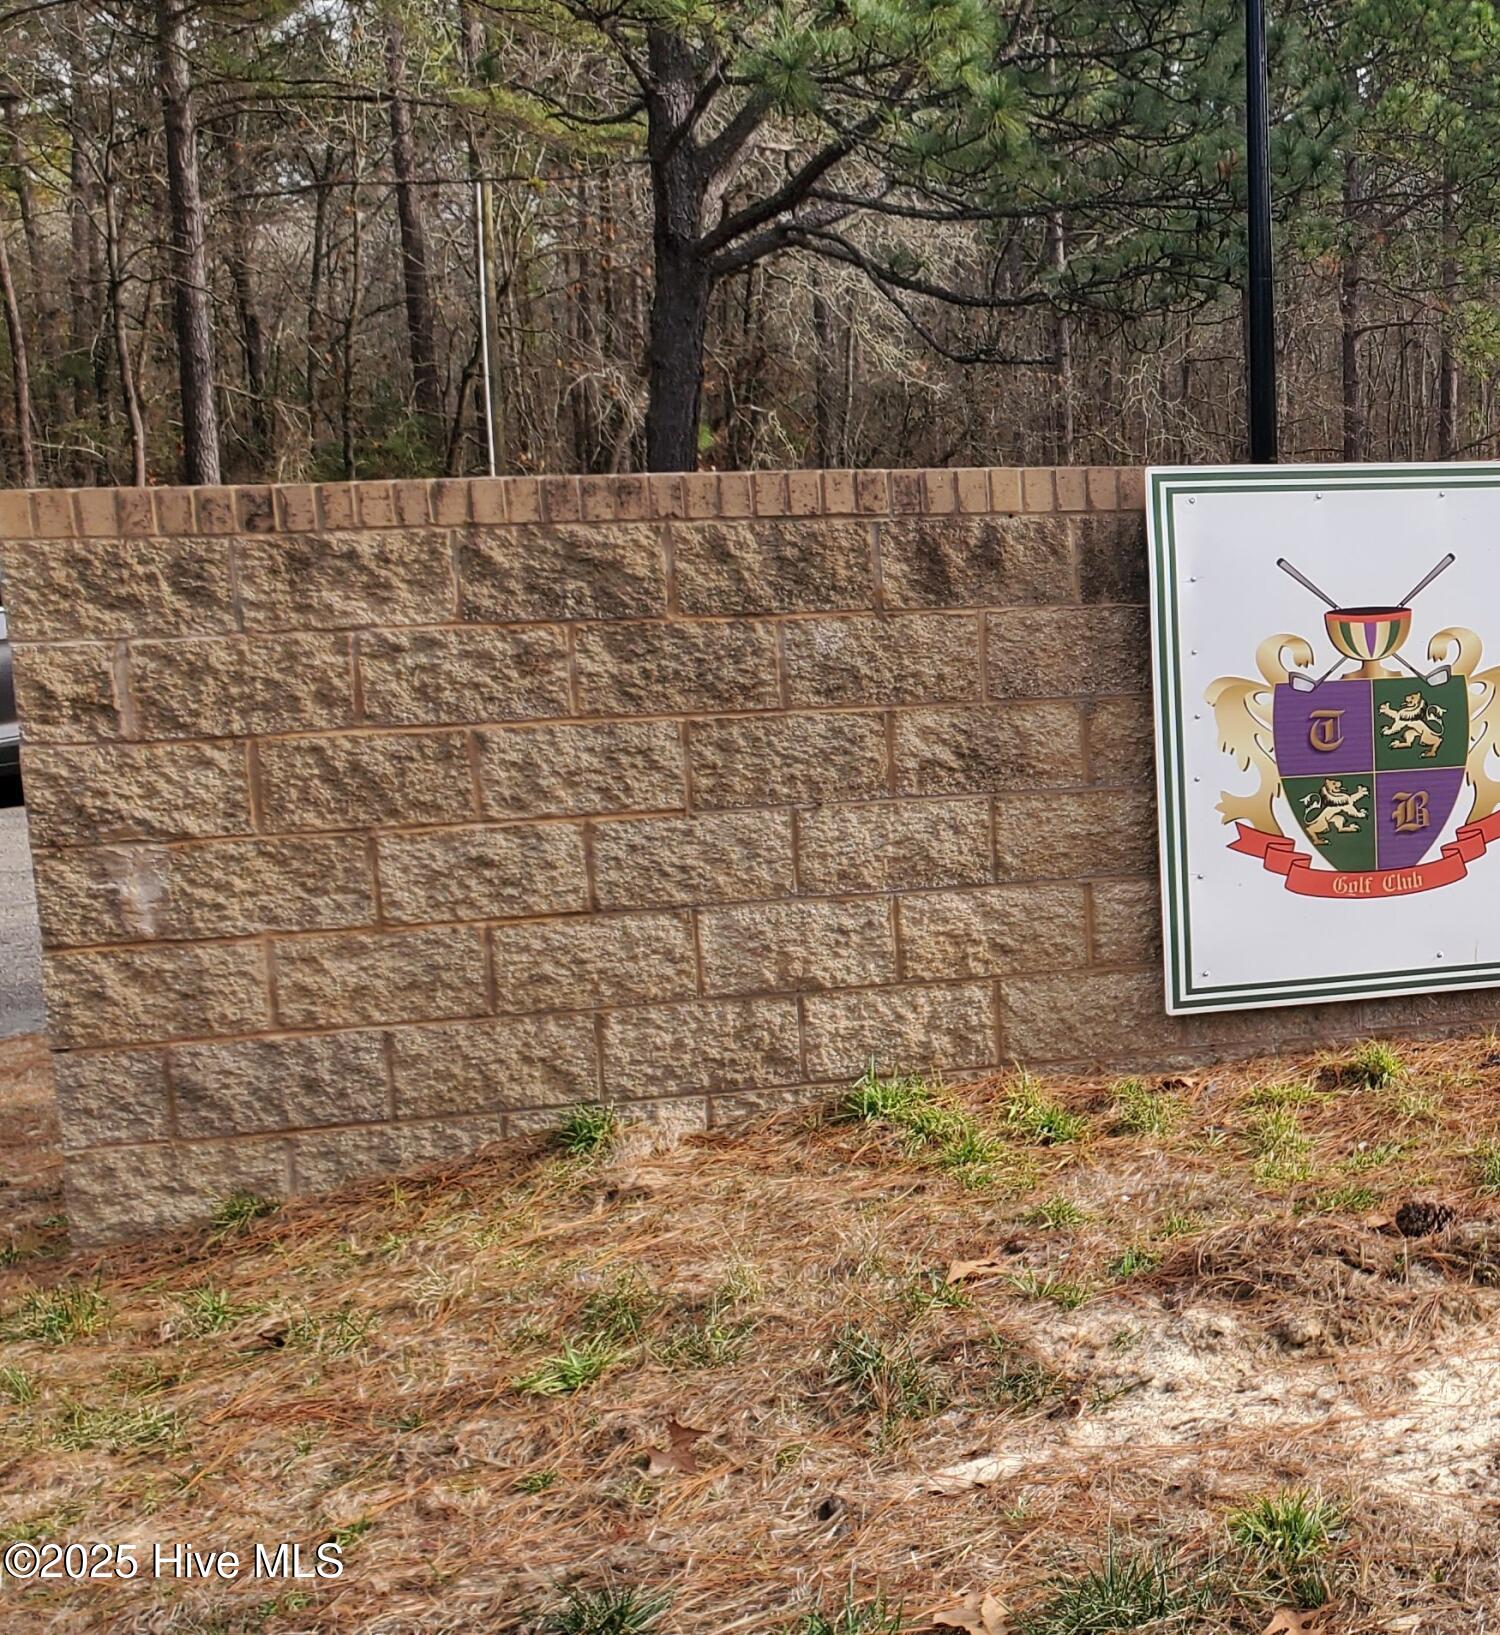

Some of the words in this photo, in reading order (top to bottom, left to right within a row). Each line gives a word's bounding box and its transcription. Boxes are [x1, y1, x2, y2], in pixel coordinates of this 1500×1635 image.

[1391, 791, 1431, 833] B
[1332, 876, 1374, 896] Golf
[1382, 871, 1423, 892] Club
